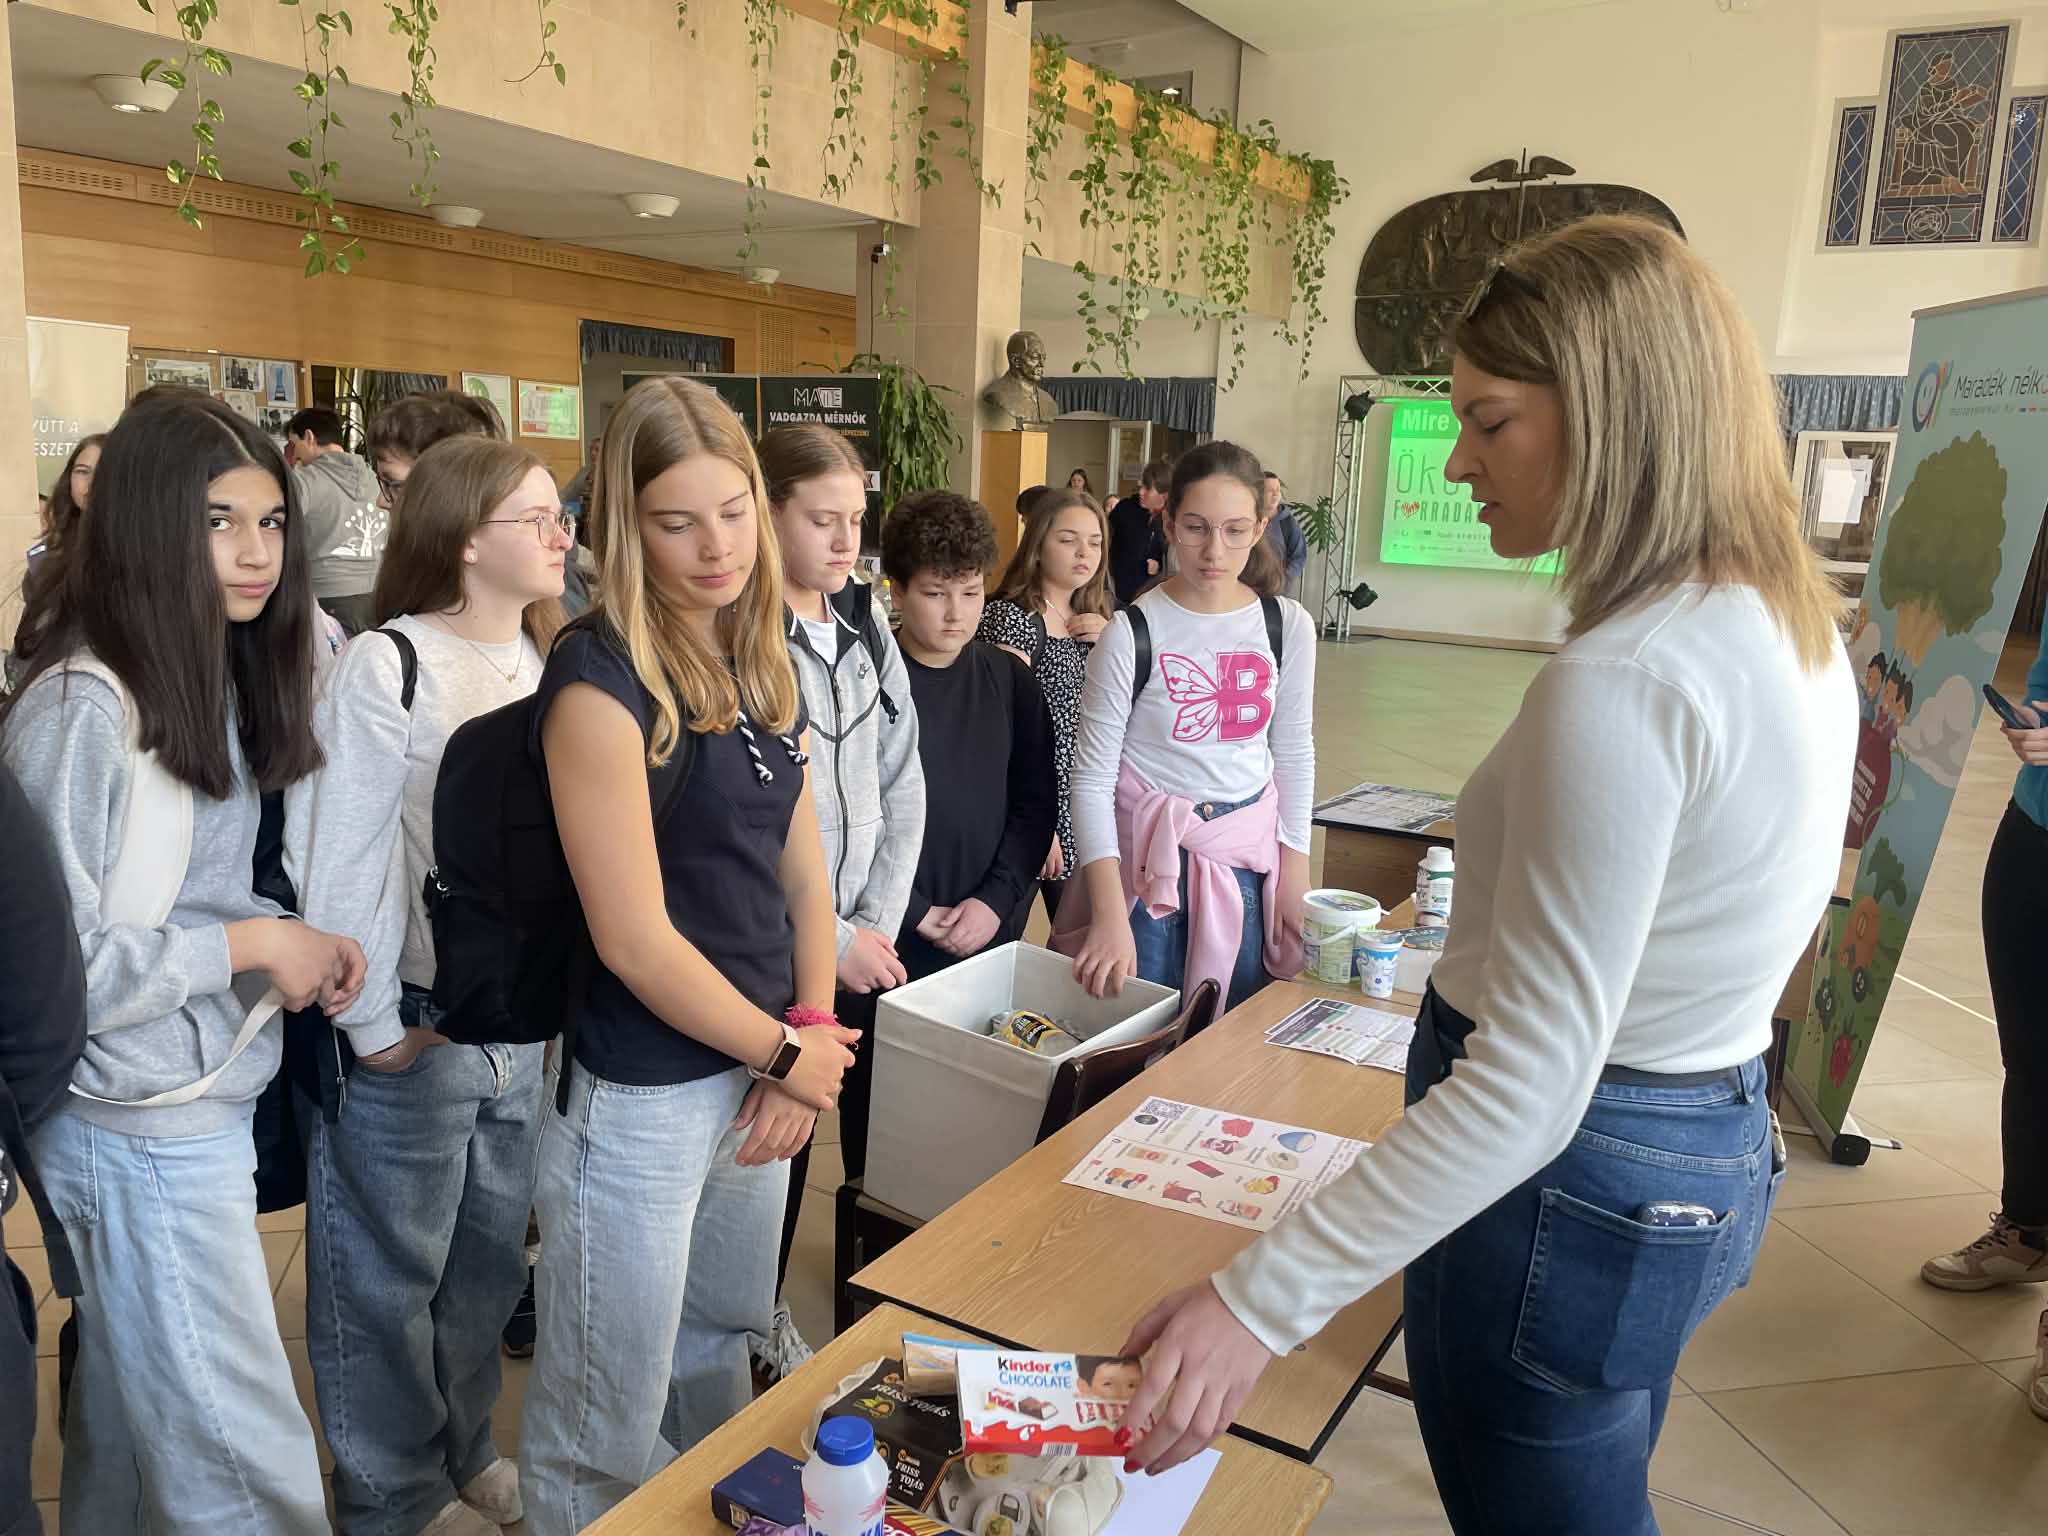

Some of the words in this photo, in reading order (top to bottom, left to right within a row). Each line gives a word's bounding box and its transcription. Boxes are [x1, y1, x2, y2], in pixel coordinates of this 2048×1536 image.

[793, 387, 843, 409] MATE
[769, 411, 823, 424] VADGAZDA
[1401, 408, 1450, 432] Mire
[1216, 651, 1273, 743] B
[999, 1372, 1073, 1389] CHOCOLATE
[895, 1461, 920, 1478] FRISS
